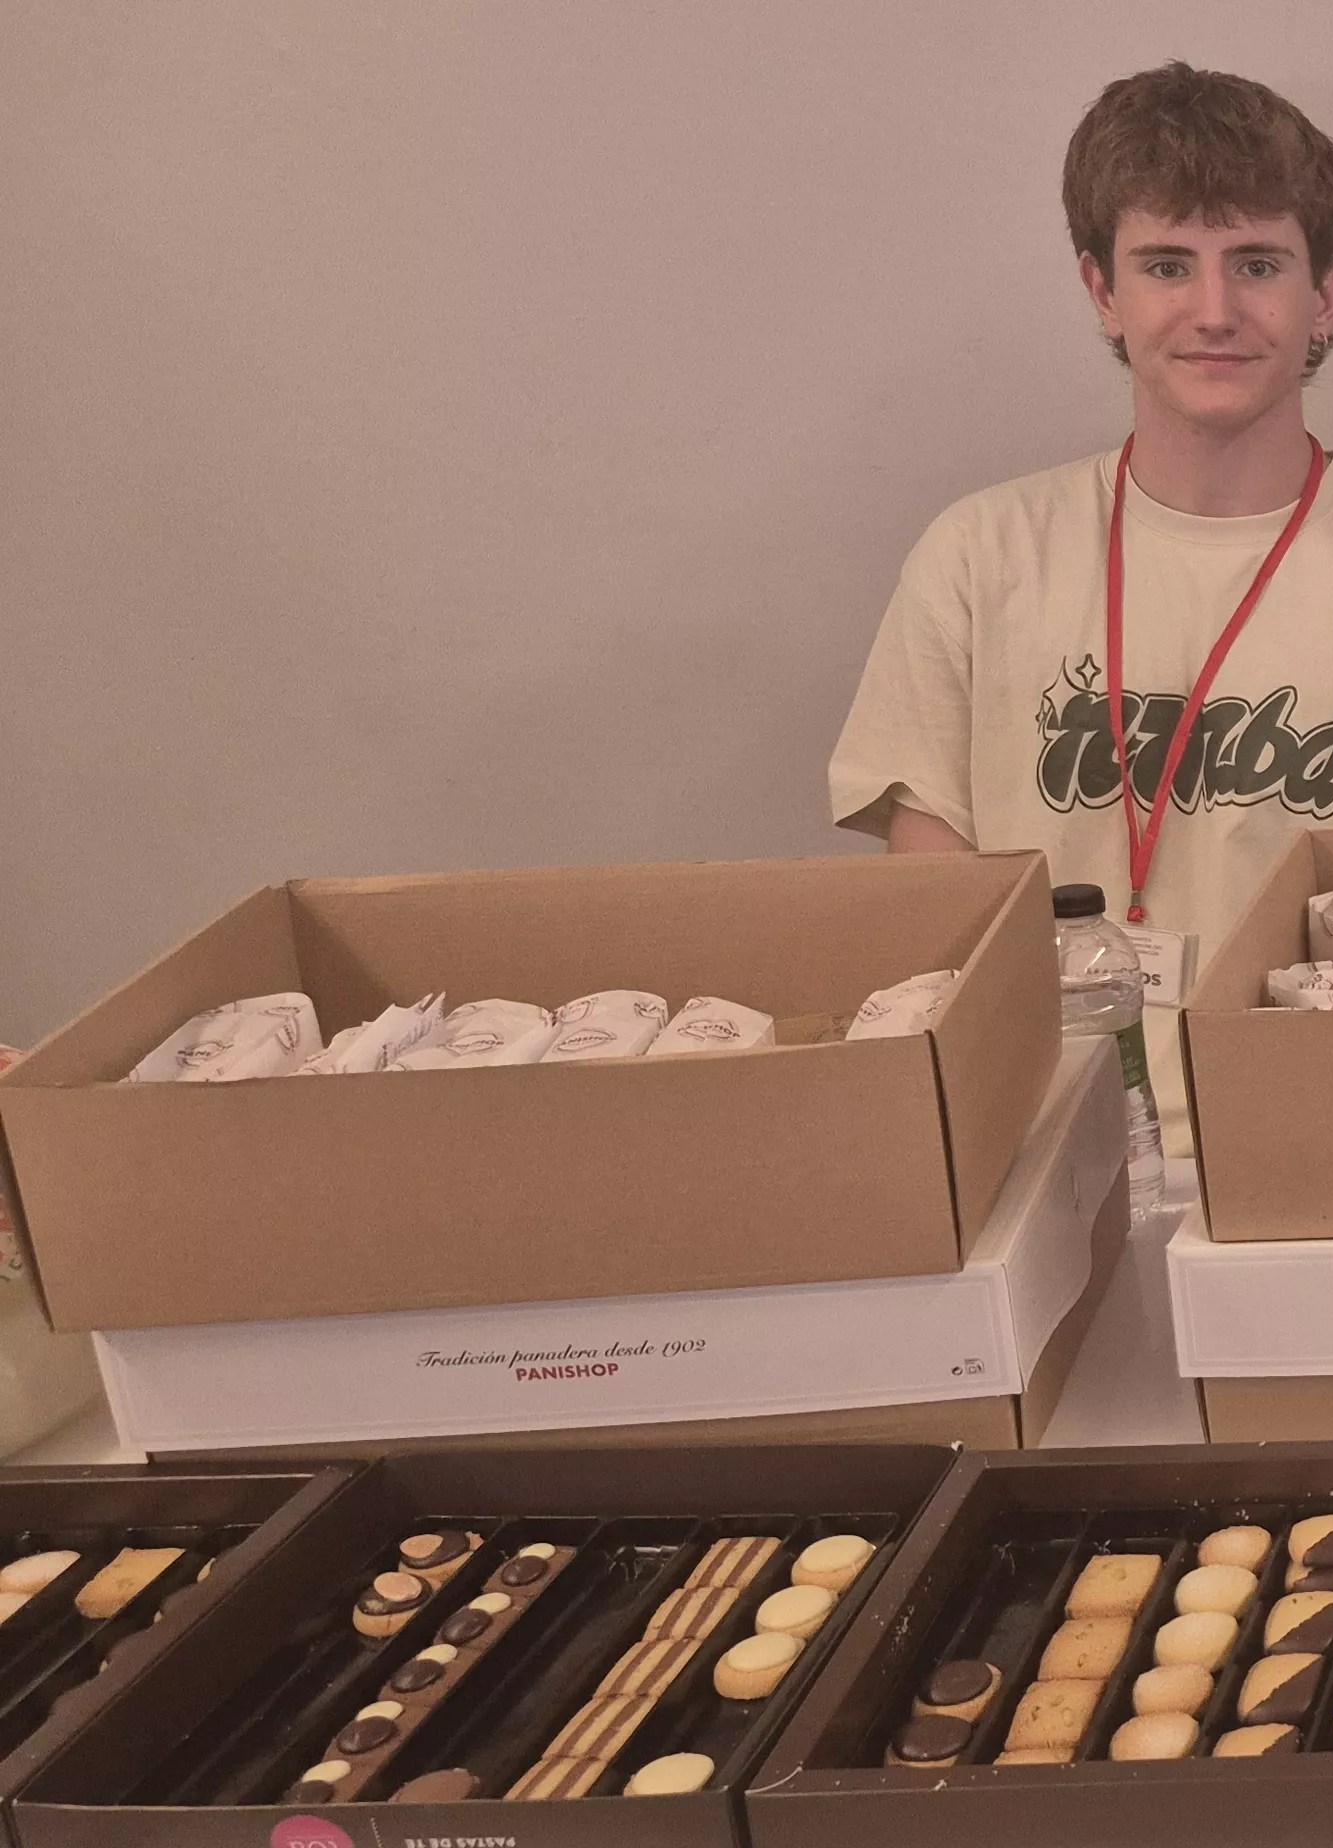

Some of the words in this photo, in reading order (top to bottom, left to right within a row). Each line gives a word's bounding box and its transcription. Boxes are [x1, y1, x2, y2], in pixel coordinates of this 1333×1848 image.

[414, 1349, 508, 1369] Tradición
[508, 1343, 600, 1370] panadera
[603, 1339, 657, 1358] desde
[661, 1339, 707, 1358] 1902
[514, 1361, 620, 1382] PANISHOP
